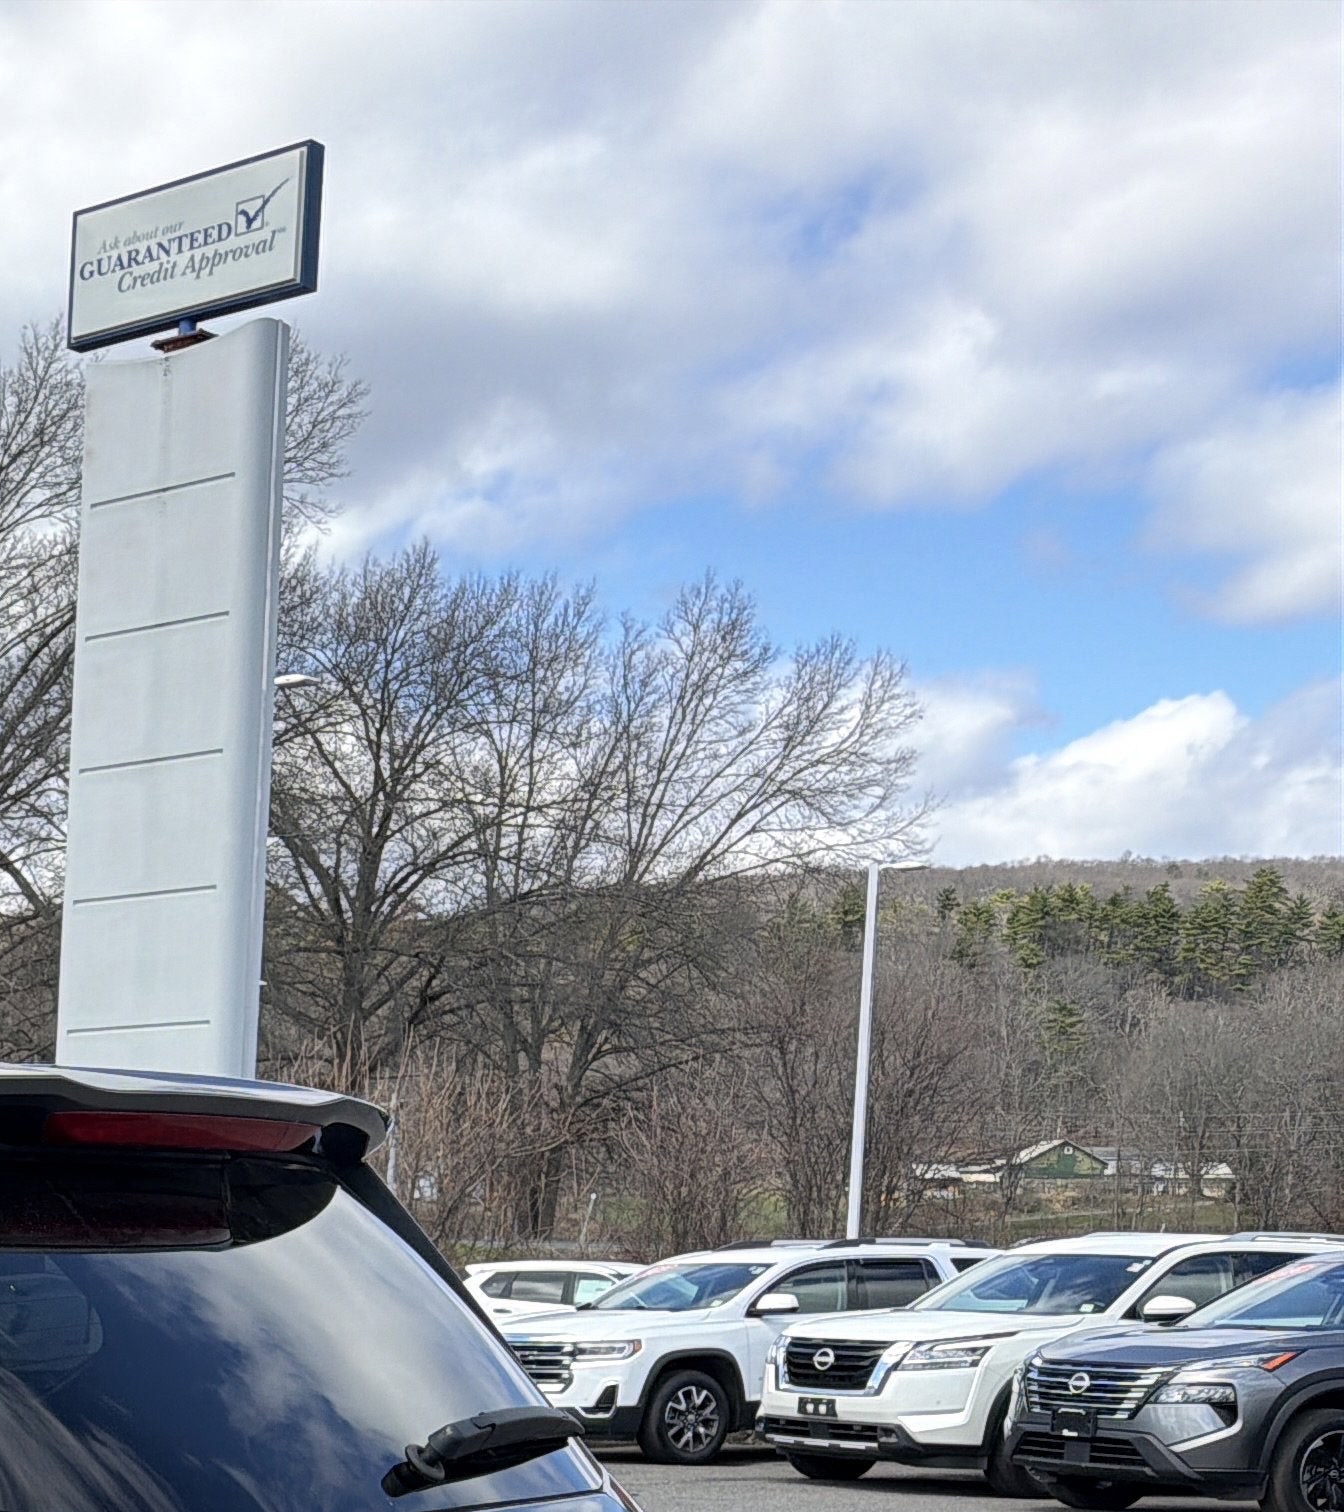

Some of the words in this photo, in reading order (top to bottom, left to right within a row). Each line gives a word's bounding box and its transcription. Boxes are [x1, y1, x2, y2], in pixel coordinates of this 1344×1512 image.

[79, 221, 233, 282] GUARANTEED
[97, 237, 120, 255] Ask
[123, 226, 159, 247] about
[161, 220, 185, 238] our
[116, 258, 178, 294] Credit
